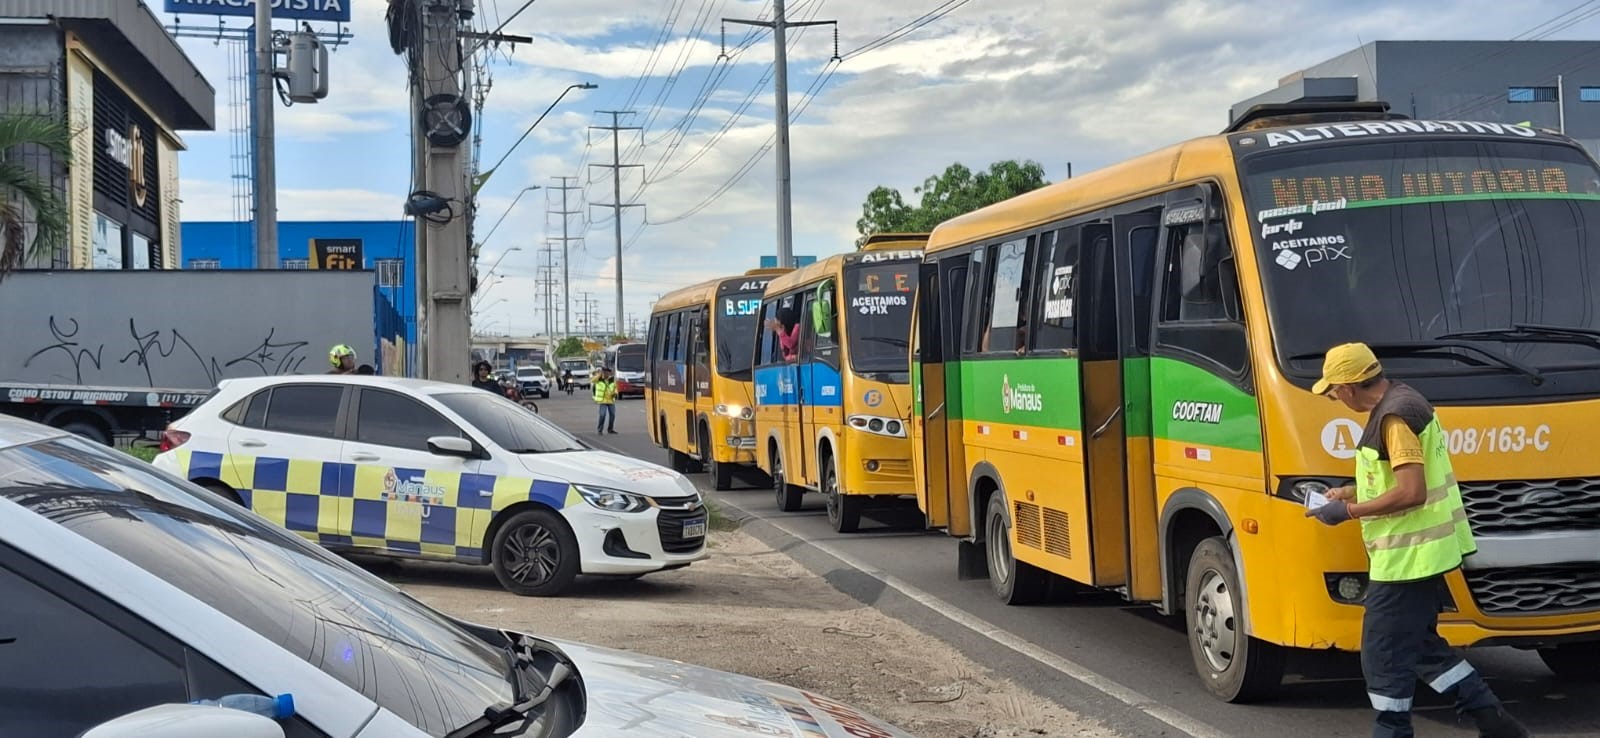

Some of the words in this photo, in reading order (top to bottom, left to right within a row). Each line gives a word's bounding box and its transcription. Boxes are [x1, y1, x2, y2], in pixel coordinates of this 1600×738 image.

[173, 0, 341, 12] DISTA
[1265, 121, 1536, 147] ALTERNATIVO
[105, 128, 133, 170] smart
[131, 124, 145, 187] fit
[326, 245, 356, 253] smart
[1272, 235, 1345, 250] ACEITAMOS
[1304, 245, 1352, 268] pix
[739, 281, 768, 290] ALT
[725, 298, 737, 315] B.
[852, 296, 907, 307] ACEITAMOS
[869, 305, 888, 315] PIX
[8, 389, 38, 397] COMO
[40, 390, 72, 399] ESTOU
[72, 391, 128, 401] DIRIGINDO?
[1010, 387, 1042, 411] Manaus
[1172, 400, 1223, 424] COOFTAM
[1332, 424, 1357, 451] A
[396, 480, 445, 496] Manaus
